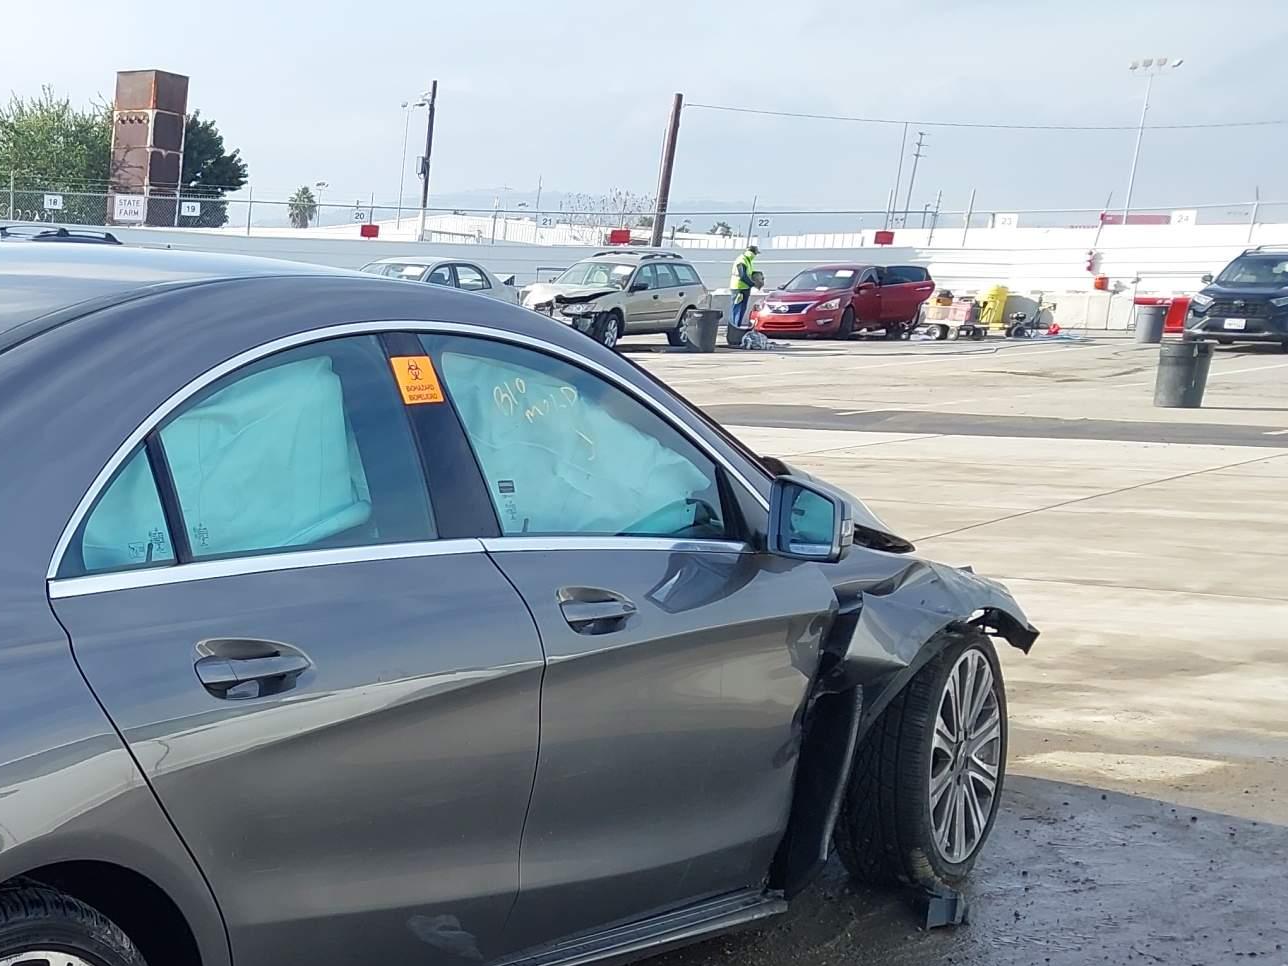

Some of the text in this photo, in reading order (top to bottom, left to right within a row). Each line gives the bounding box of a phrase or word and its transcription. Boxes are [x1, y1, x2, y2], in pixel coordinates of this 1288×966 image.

[49, 198, 58, 206] 18
[118, 199, 141, 207] STATE
[119, 208, 139, 217] FARM
[186, 205, 196, 213] 19
[354, 212, 365, 220] 20
[1177, 214, 1190, 223] 24
[542, 217, 552, 226] 21
[758, 218, 769, 227] 22
